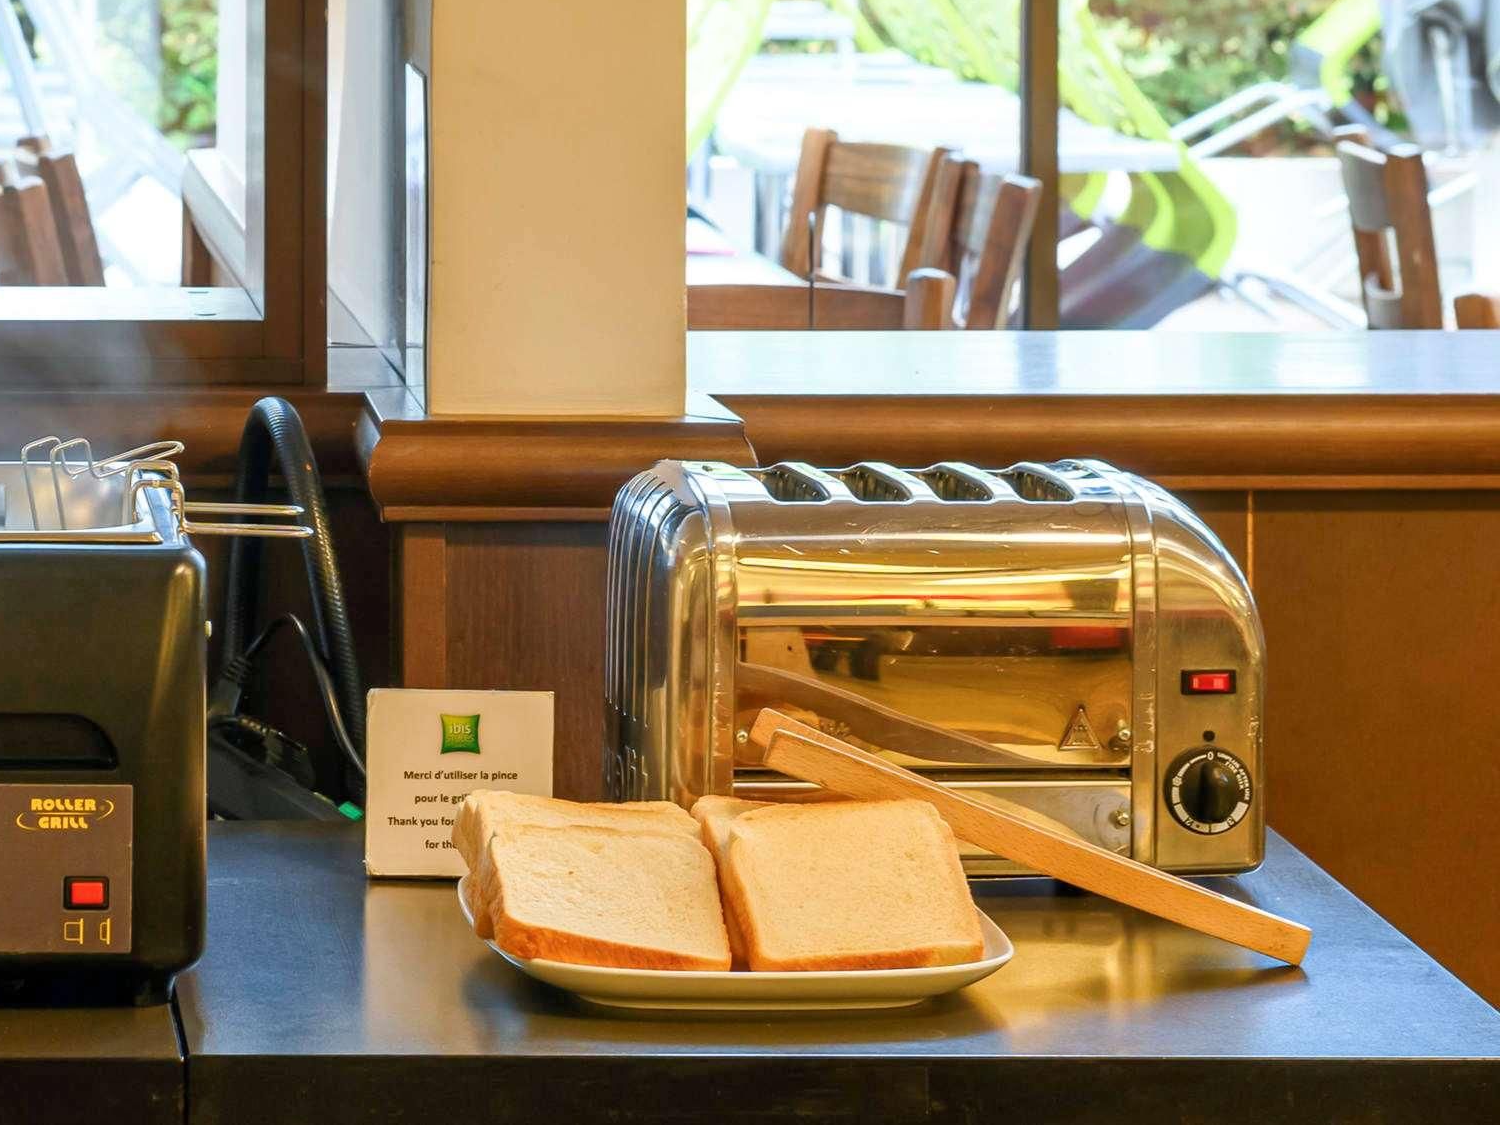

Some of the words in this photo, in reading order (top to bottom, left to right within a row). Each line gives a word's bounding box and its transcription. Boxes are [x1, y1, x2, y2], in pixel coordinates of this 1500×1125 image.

[403, 770, 432, 780] Merci
[480, 770, 489, 780] la
[491, 770, 518, 782] pince
[30, 798, 96, 811] ROLLER
[414, 795, 438, 805] pour
[440, 793, 450, 803] le
[38, 816, 88, 829] GRILL
[387, 816, 418, 826] Thank
[419, 818, 438, 828] you
[425, 839, 439, 849] for
